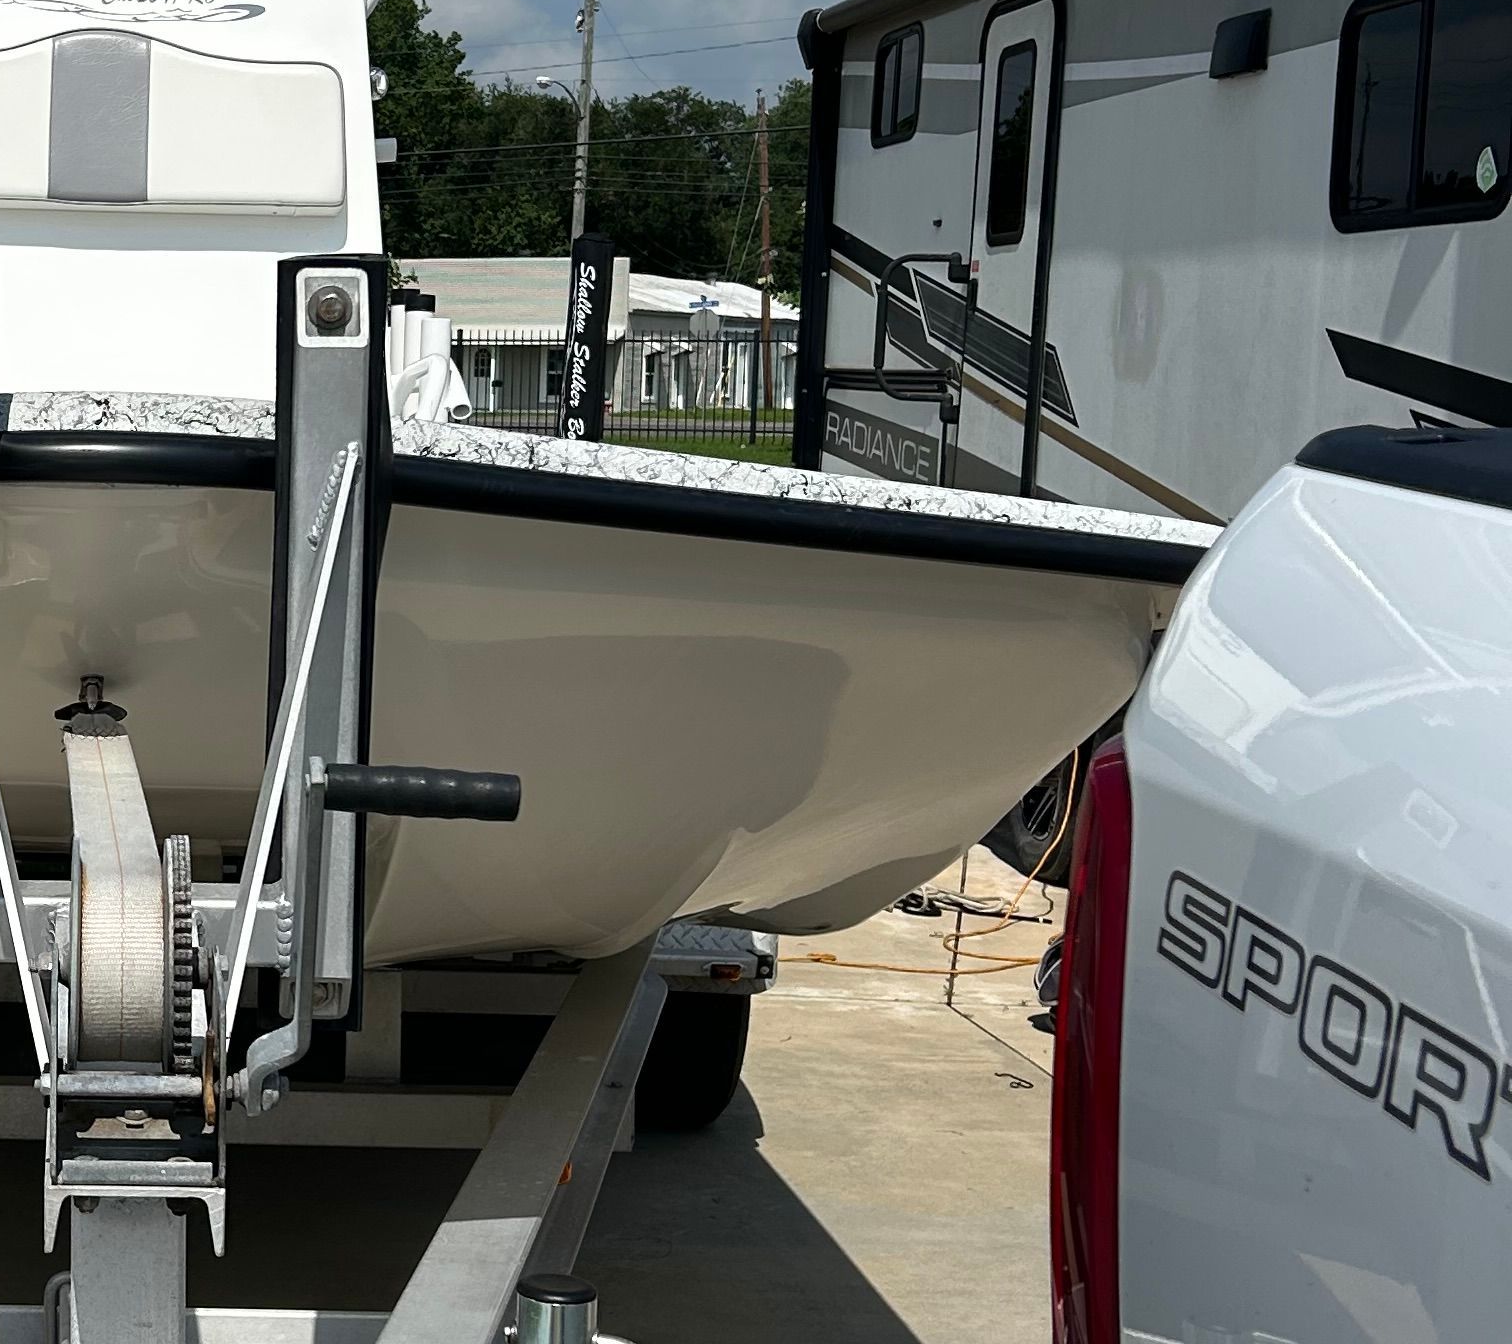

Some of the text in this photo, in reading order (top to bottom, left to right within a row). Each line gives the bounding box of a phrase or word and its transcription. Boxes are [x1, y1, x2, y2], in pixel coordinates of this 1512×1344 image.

[567, 261, 596, 440] Shallow Stalker Bo
[825, 410, 931, 482] RADIANCE
[1156, 868, 1512, 1182] SPOR
